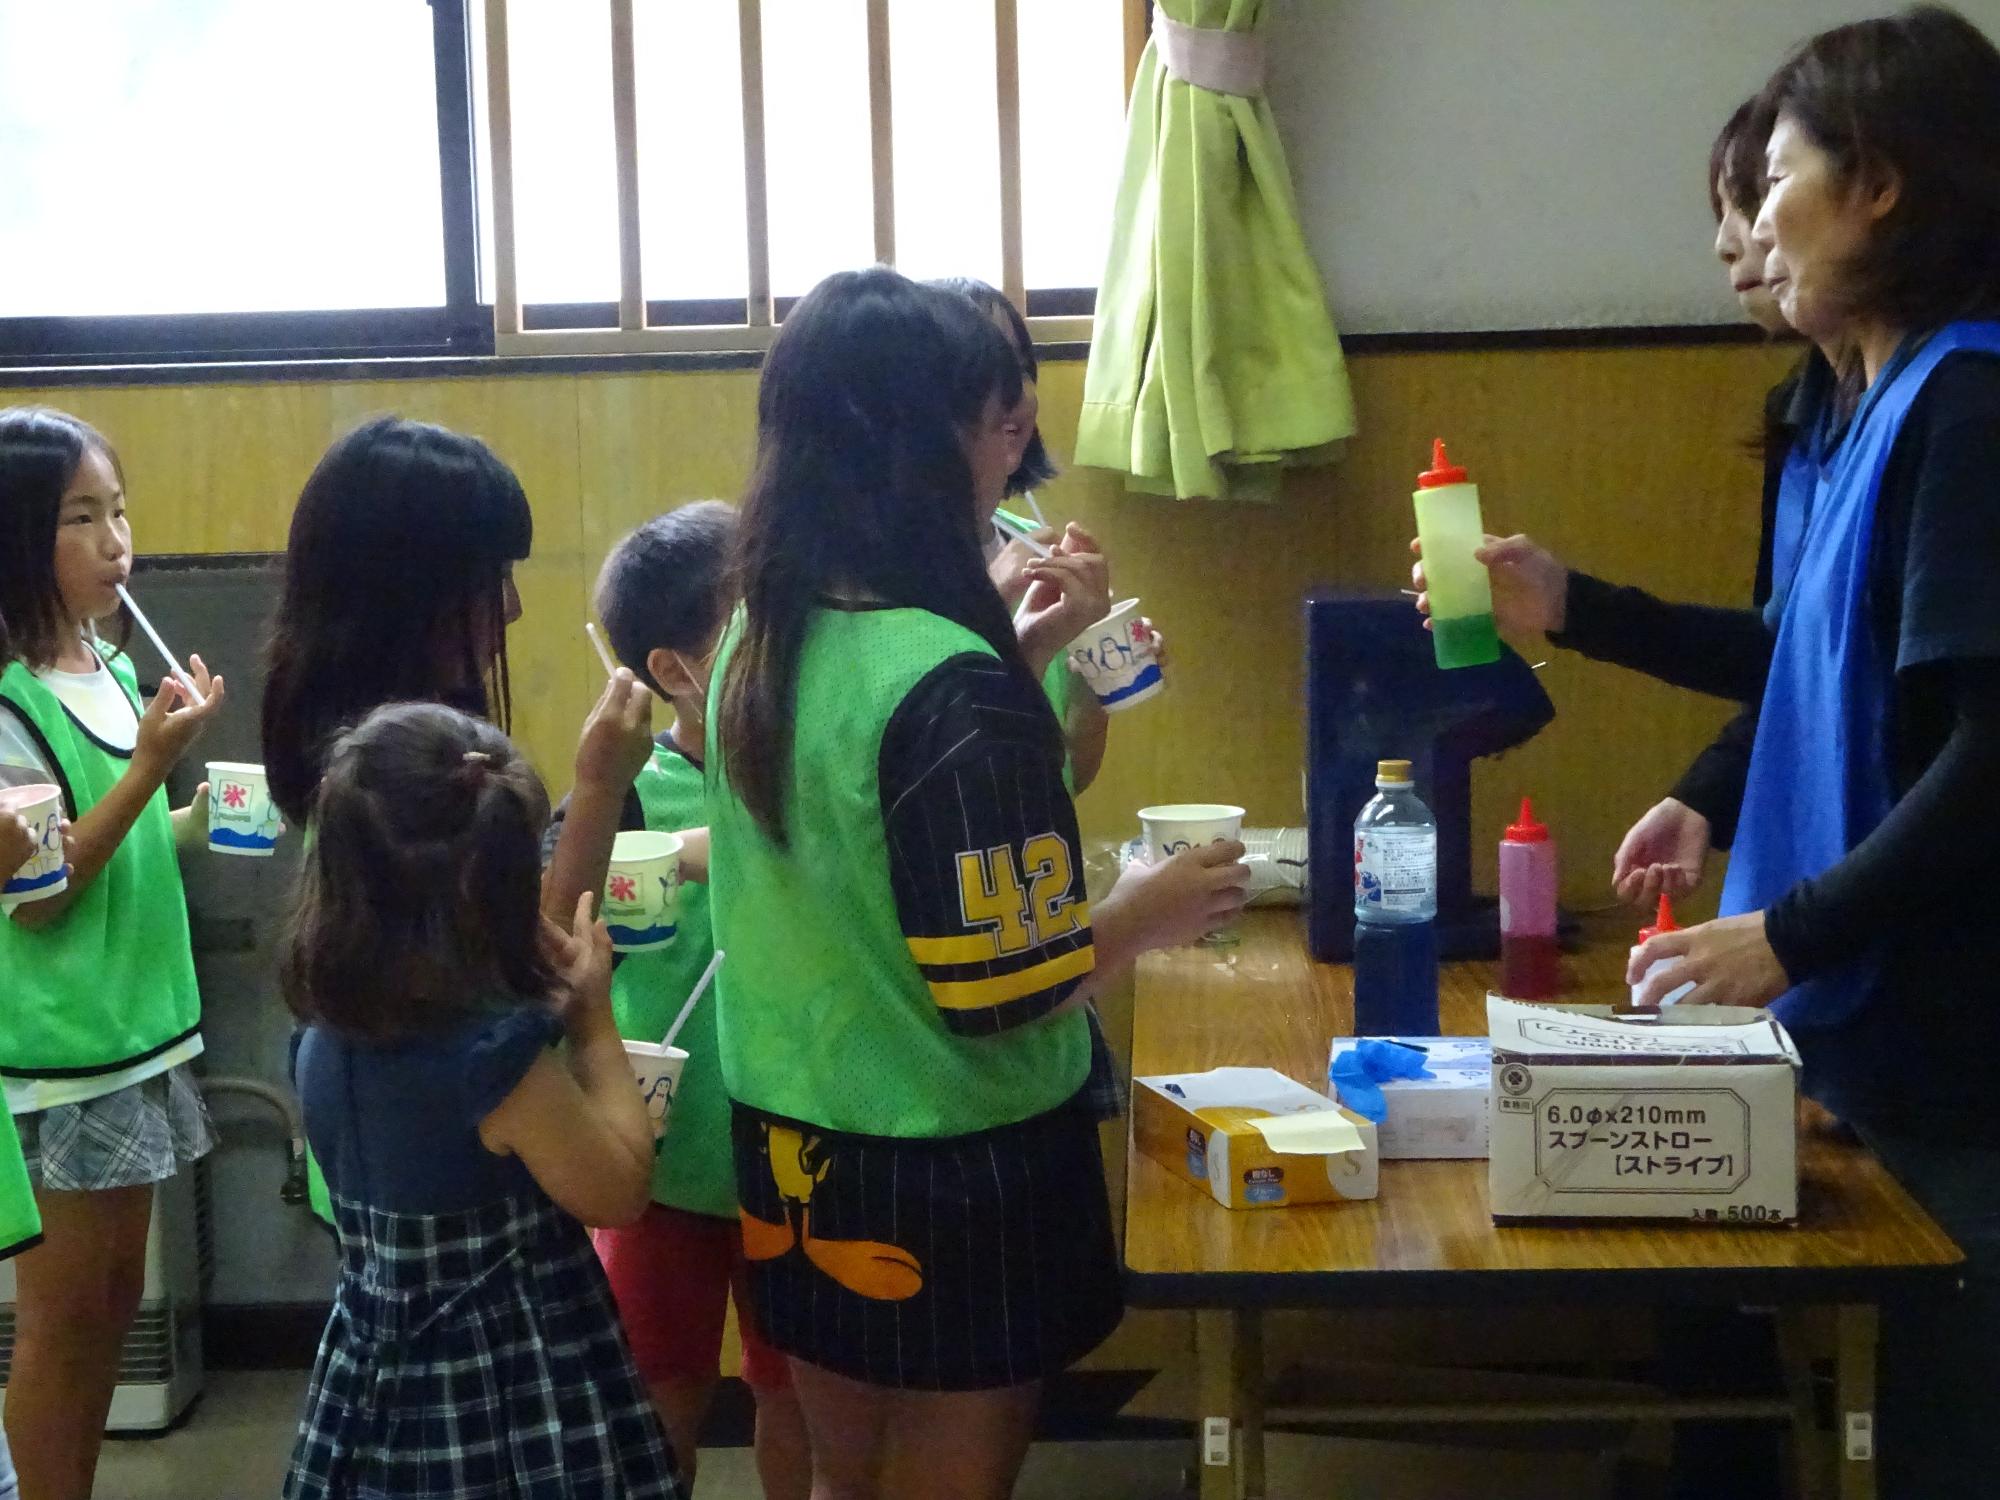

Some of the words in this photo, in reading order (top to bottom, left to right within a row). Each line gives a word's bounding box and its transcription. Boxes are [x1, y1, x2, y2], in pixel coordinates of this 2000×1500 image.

[223, 784, 247, 808] 氷
[608, 875, 637, 902] 氷
[955, 831, 1083, 957] 42
[1549, 1130, 1713, 1150] スプーンストロー
